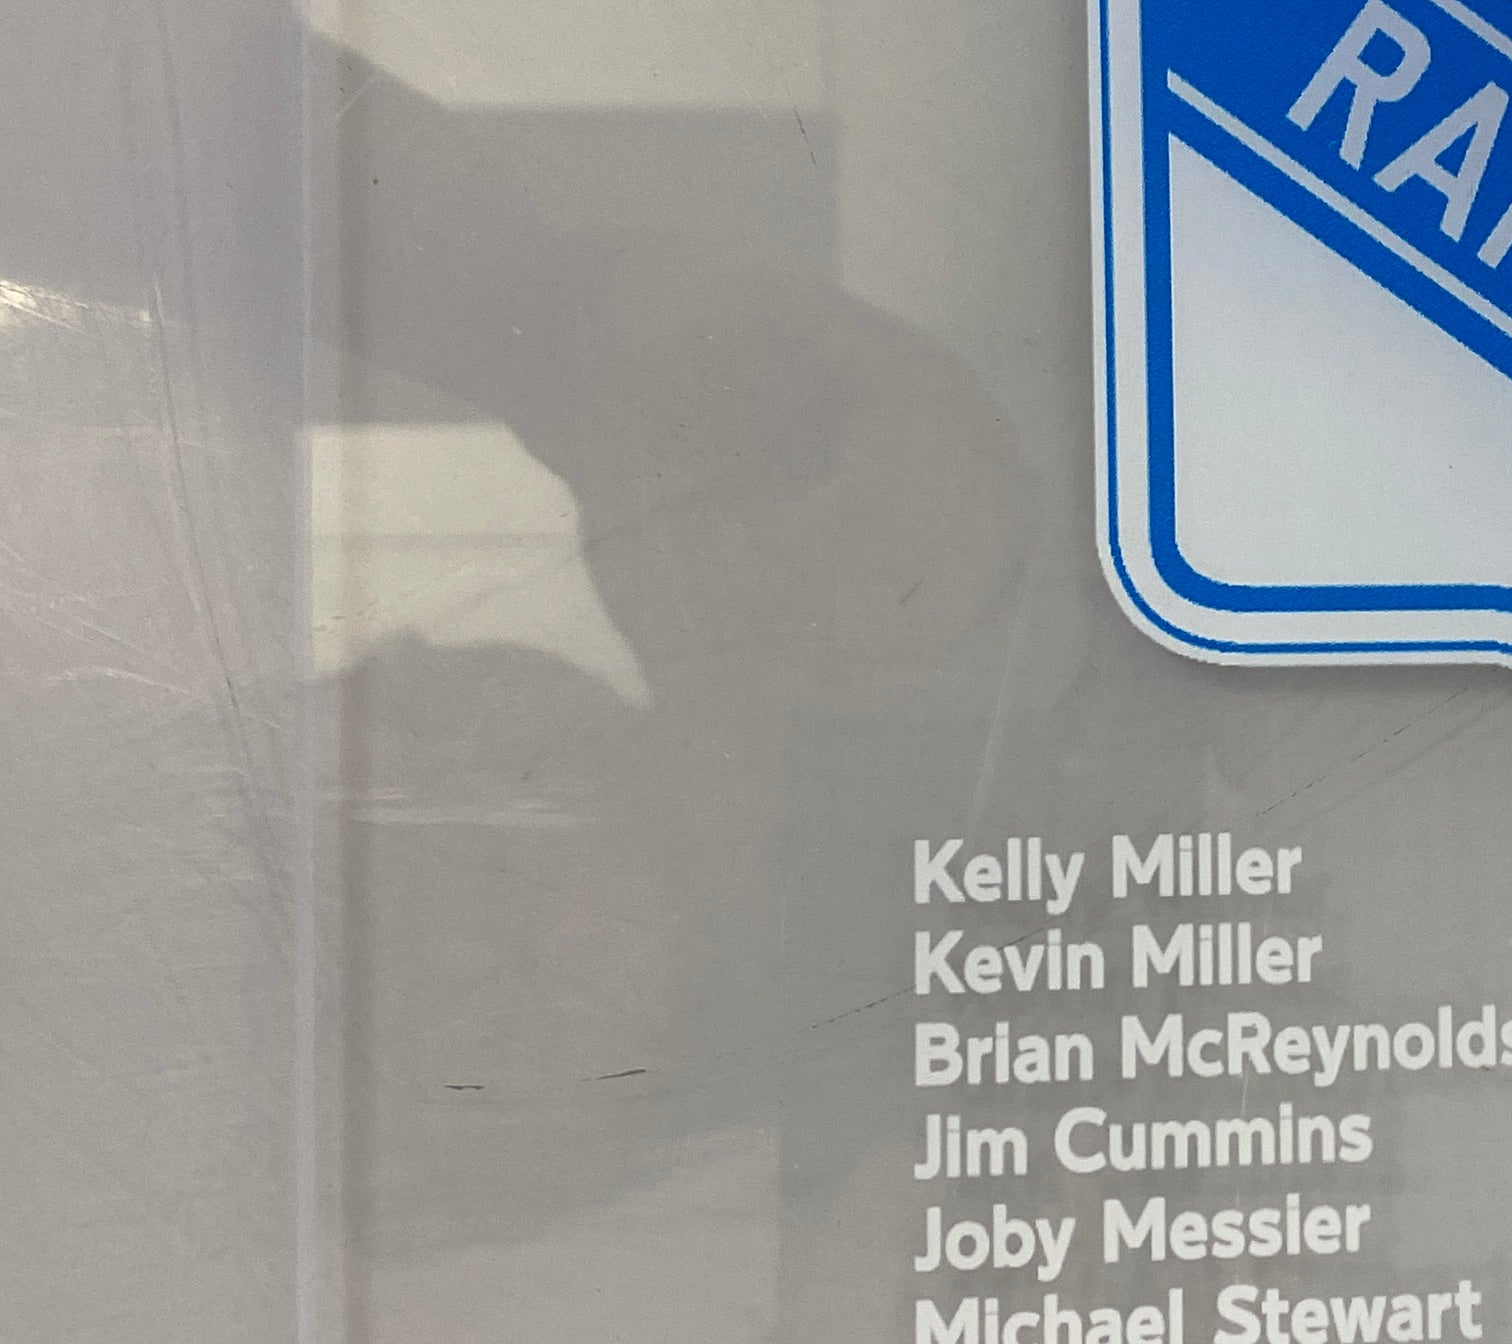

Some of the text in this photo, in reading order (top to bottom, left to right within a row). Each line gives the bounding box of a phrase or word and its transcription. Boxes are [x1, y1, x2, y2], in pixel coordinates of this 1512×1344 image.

[913, 831, 1304, 917] Kelly Miller
[913, 921, 1324, 997] Kevin Miller
[913, 1020, 1095, 1088] Brian
[912, 1101, 1375, 1181] Jim Cummins
[913, 1192, 1373, 1283] Joby Messier
